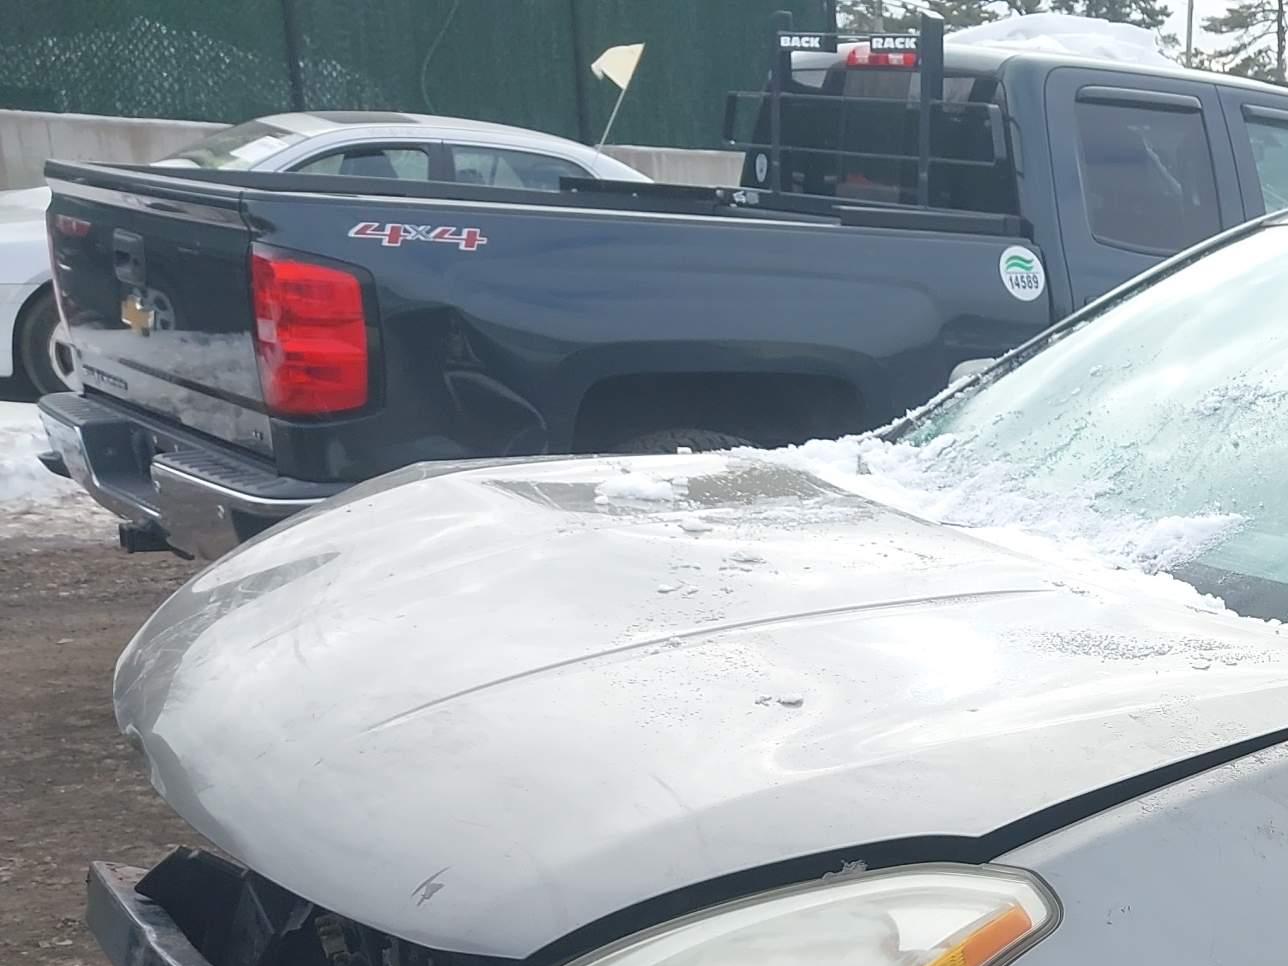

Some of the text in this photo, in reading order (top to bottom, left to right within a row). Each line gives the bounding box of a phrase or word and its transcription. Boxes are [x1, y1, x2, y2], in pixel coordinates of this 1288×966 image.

[780, 36, 917, 49] BACK RACK
[1009, 274, 1039, 290] 14589
